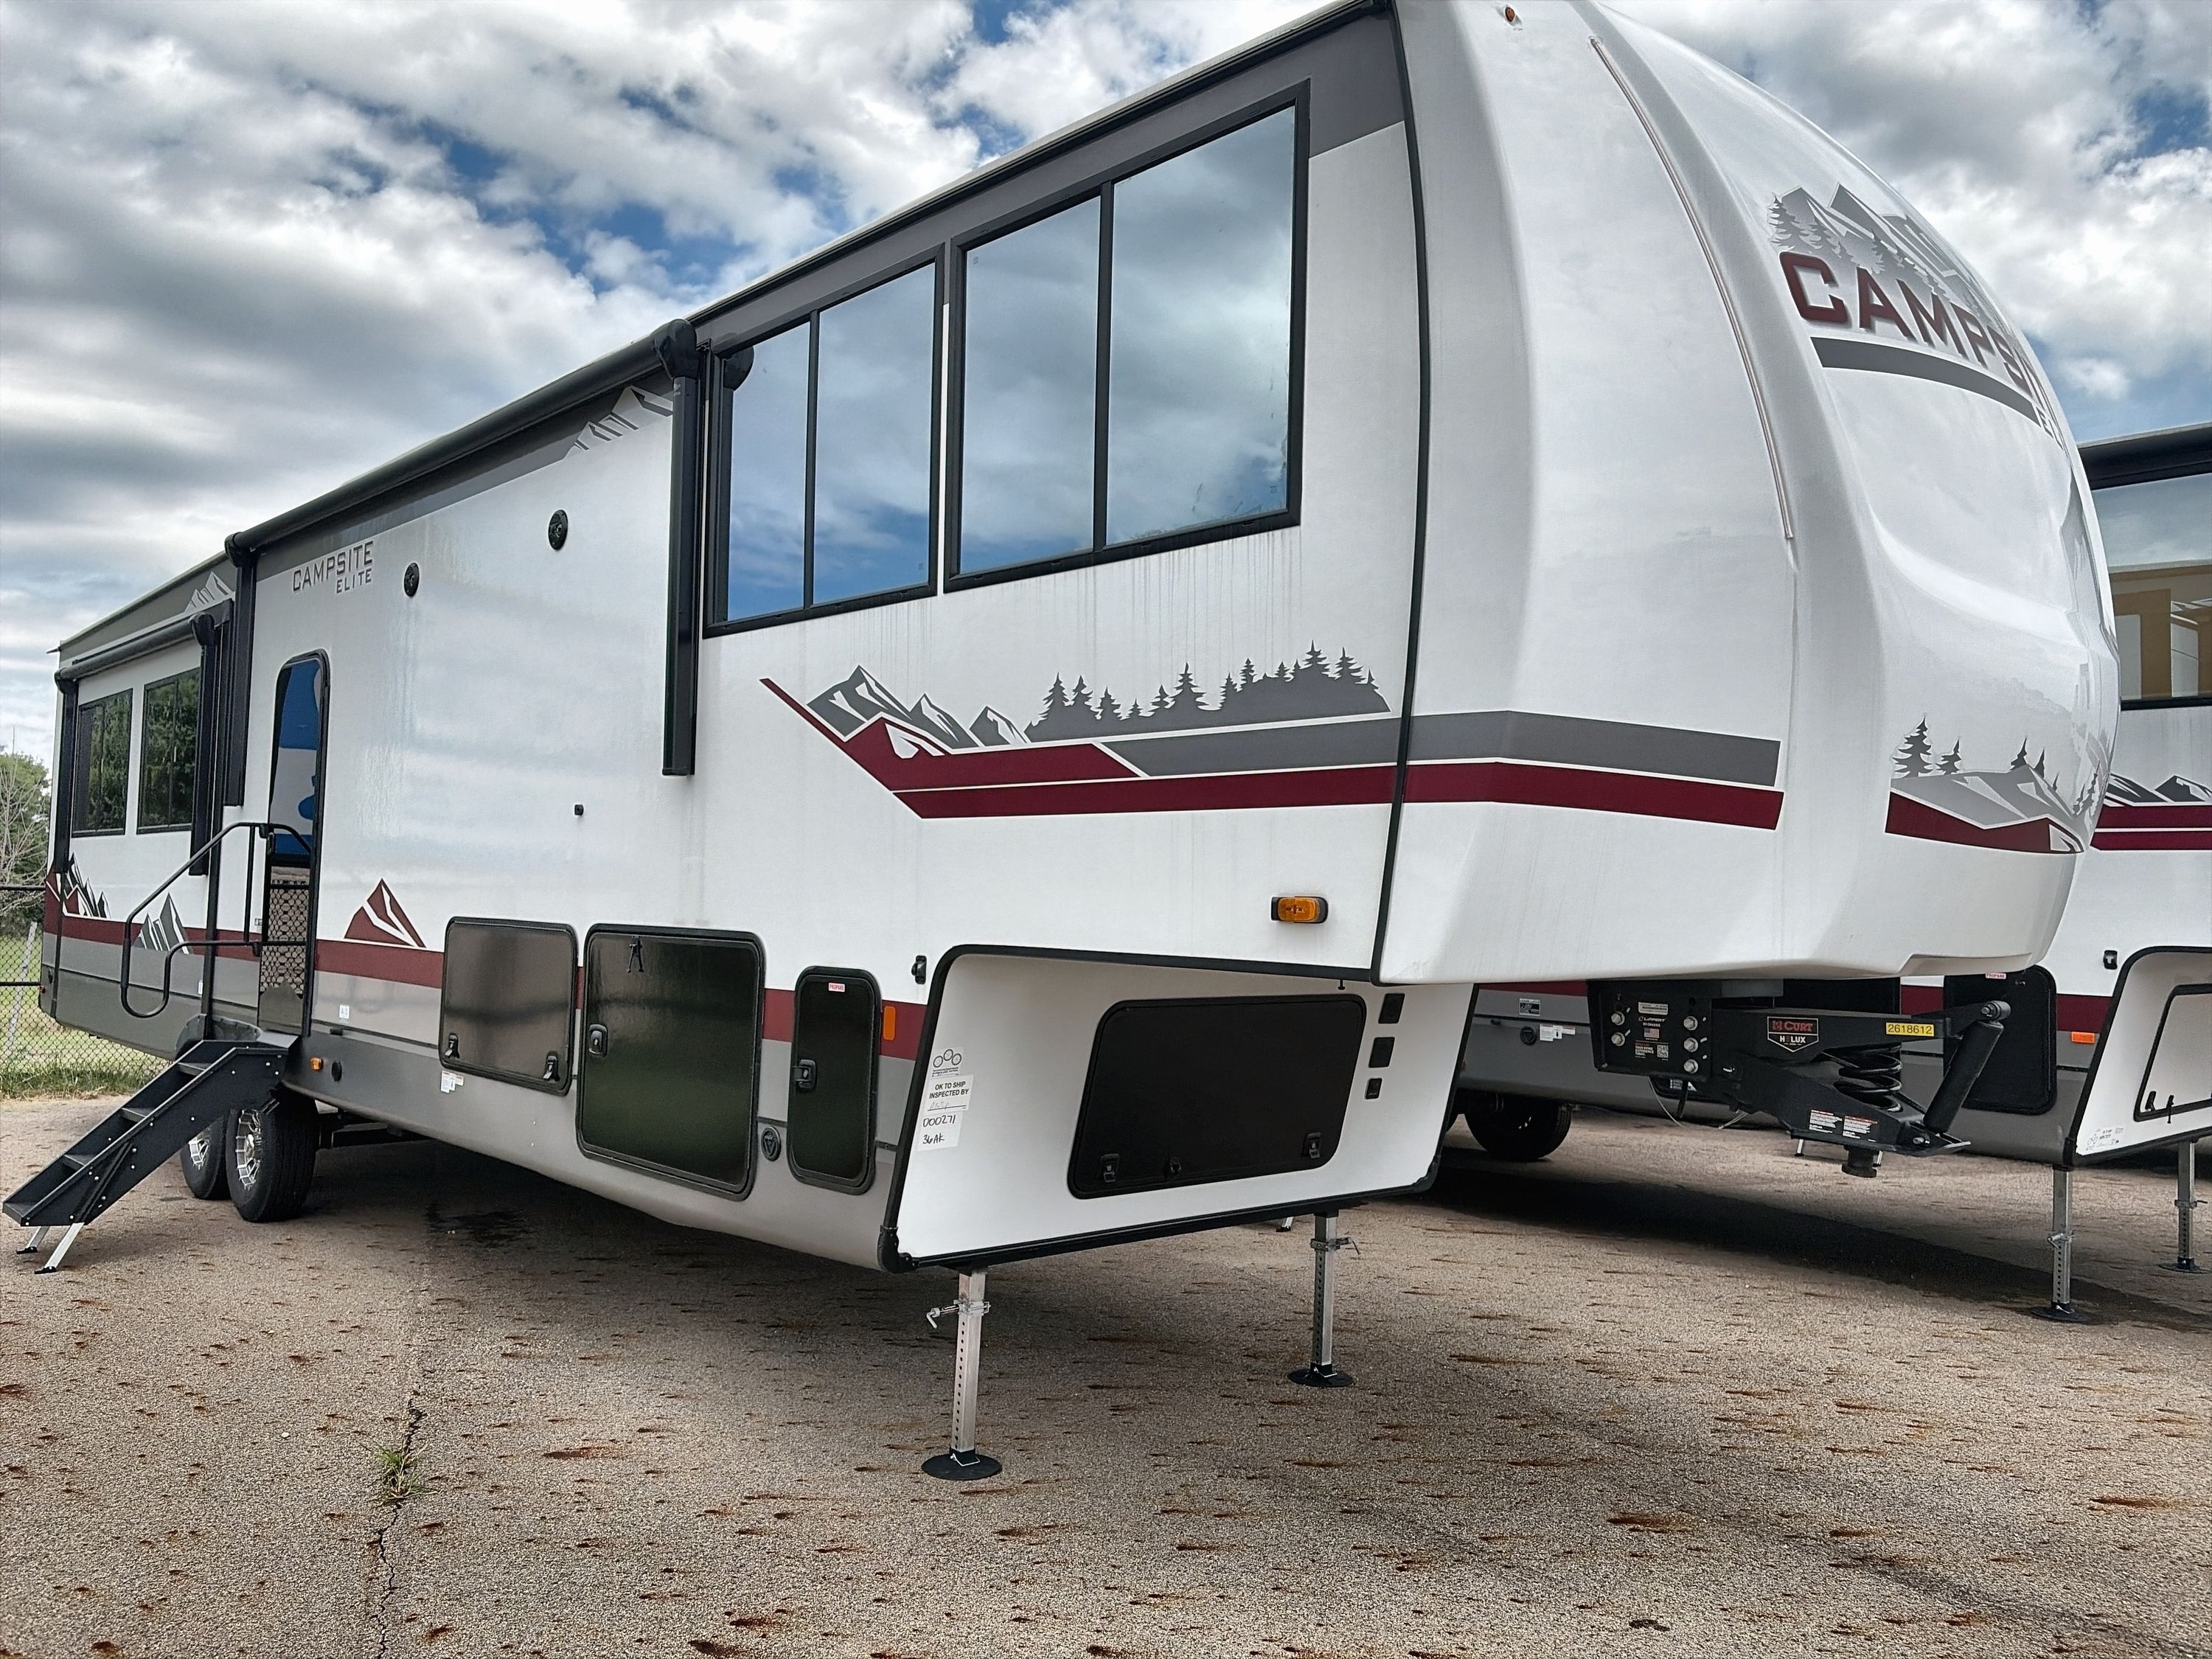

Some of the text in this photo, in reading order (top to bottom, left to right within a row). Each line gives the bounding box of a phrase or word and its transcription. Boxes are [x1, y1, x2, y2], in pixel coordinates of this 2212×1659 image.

[293, 540, 374, 592] CAMPSITE
[335, 567, 372, 594] ELITE
[1888, 1023, 1933, 1034] 2618612
[929, 1089, 960, 1099] INSPECTED
